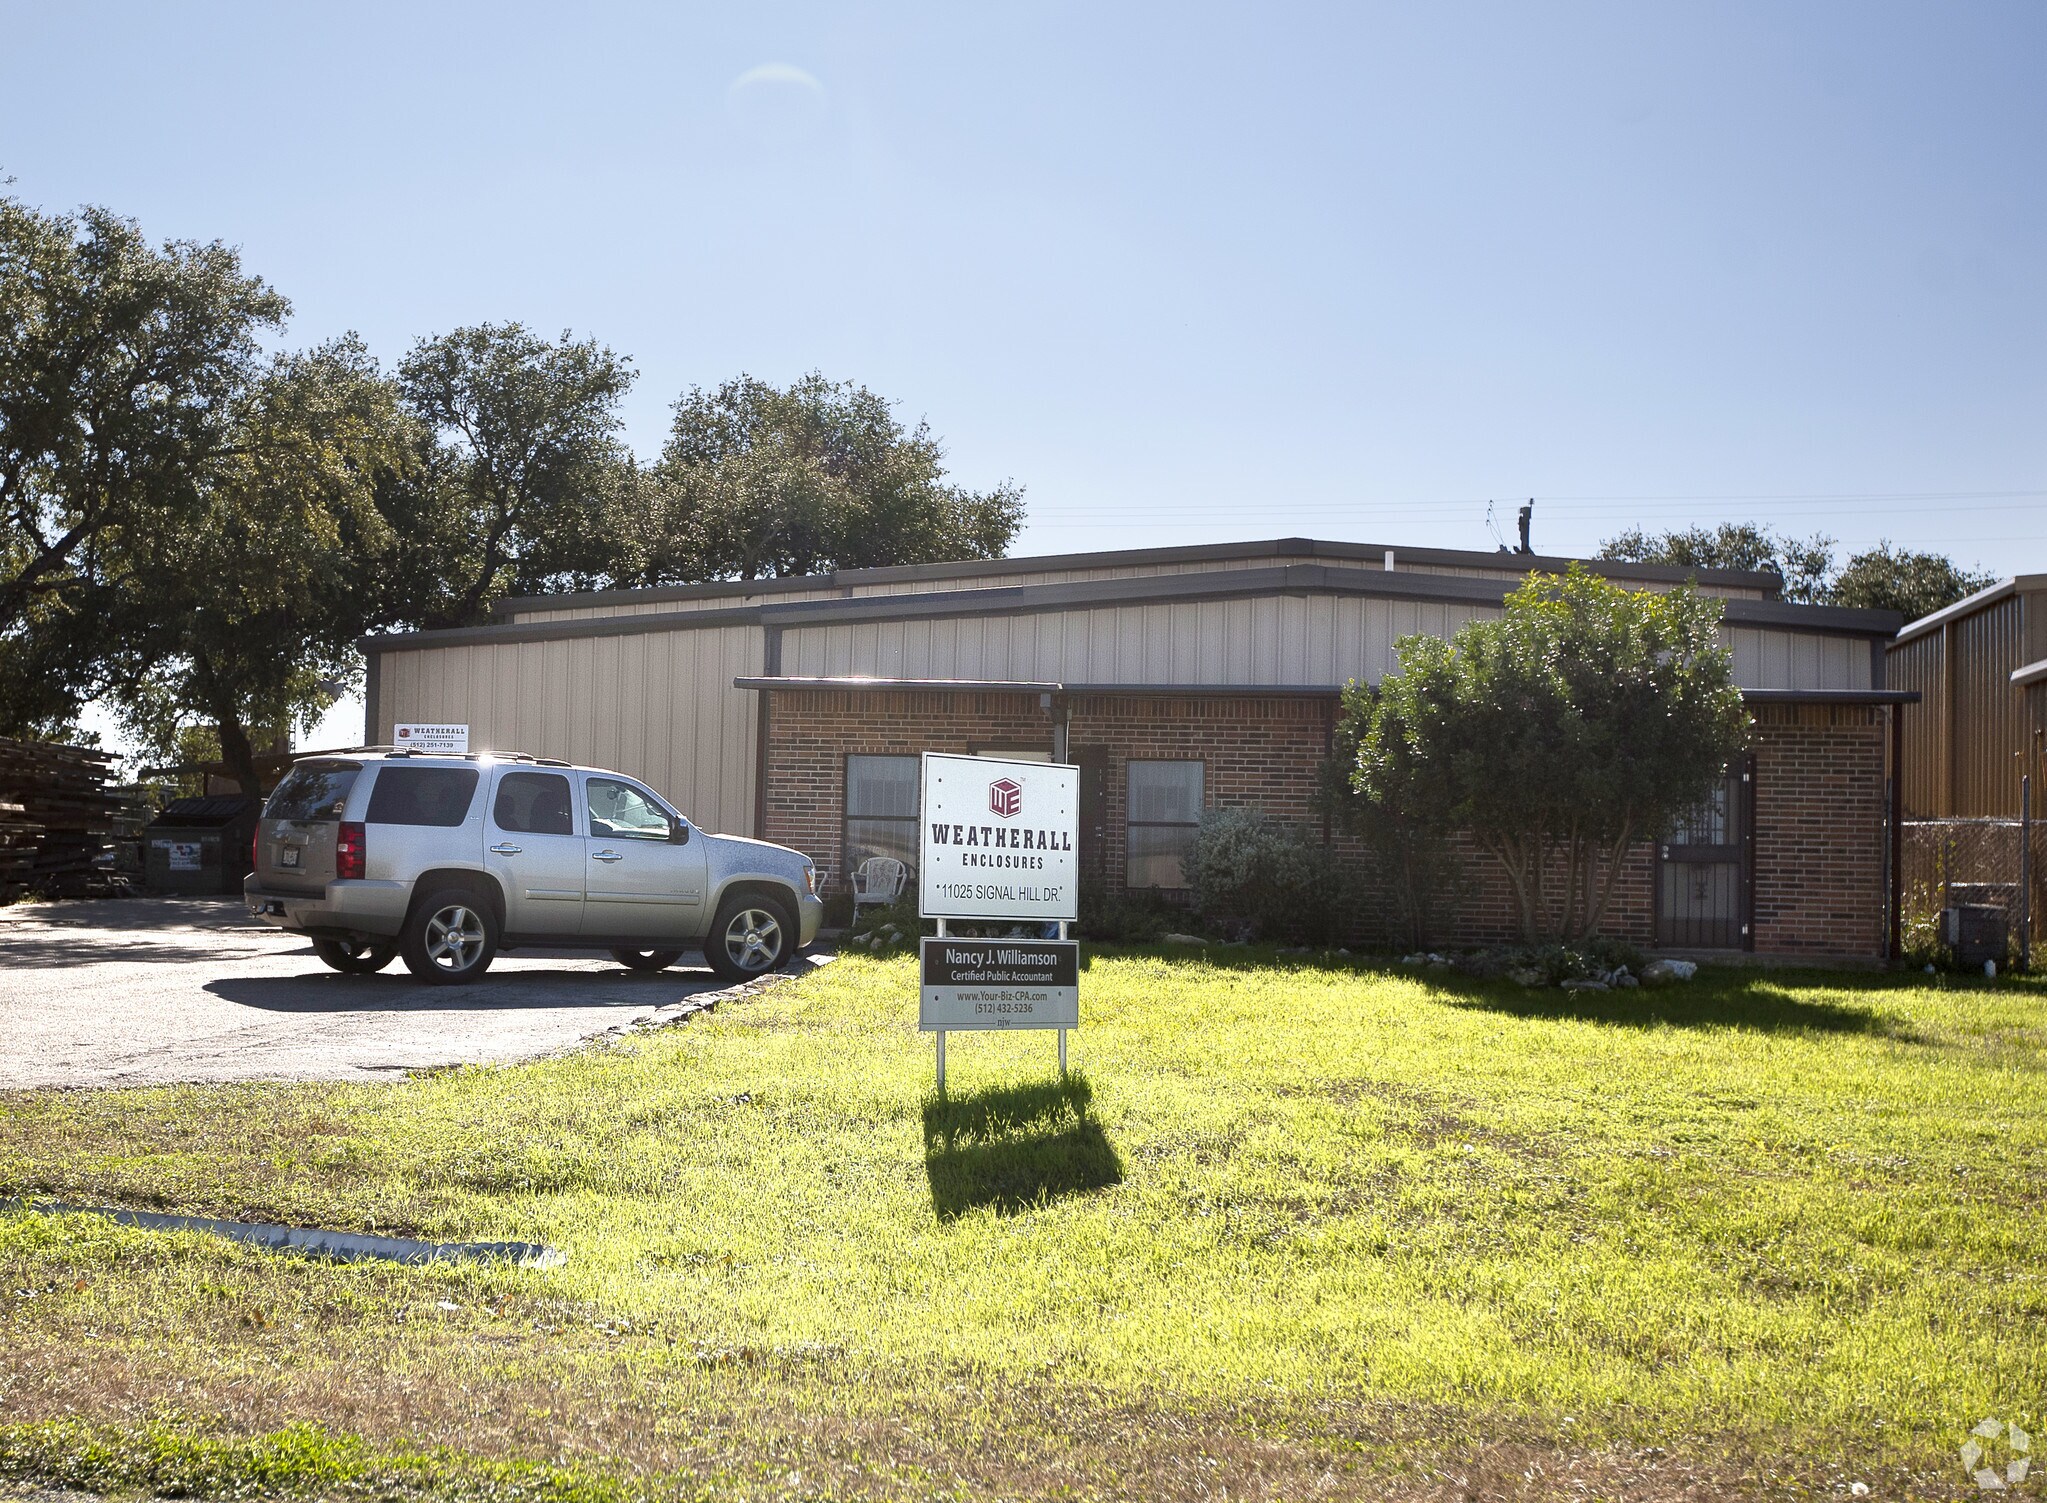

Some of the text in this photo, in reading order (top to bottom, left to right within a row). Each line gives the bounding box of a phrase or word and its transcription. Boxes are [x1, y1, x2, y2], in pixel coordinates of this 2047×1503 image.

[931, 823, 1071, 851] WEATHERALL
[962, 853, 1043, 869] ENCLOSURES
[942, 883, 1061, 902] 11025 SIGNAL HILL DR.
[945, 948, 1058, 968] Nancy J. Williamson
[950, 970, 1053, 982] Certified Public Accountant
[956, 990, 1048, 1001] www.Your-Biz-CPA.com
[975, 1003, 1033, 1015] (512) 432-5236
